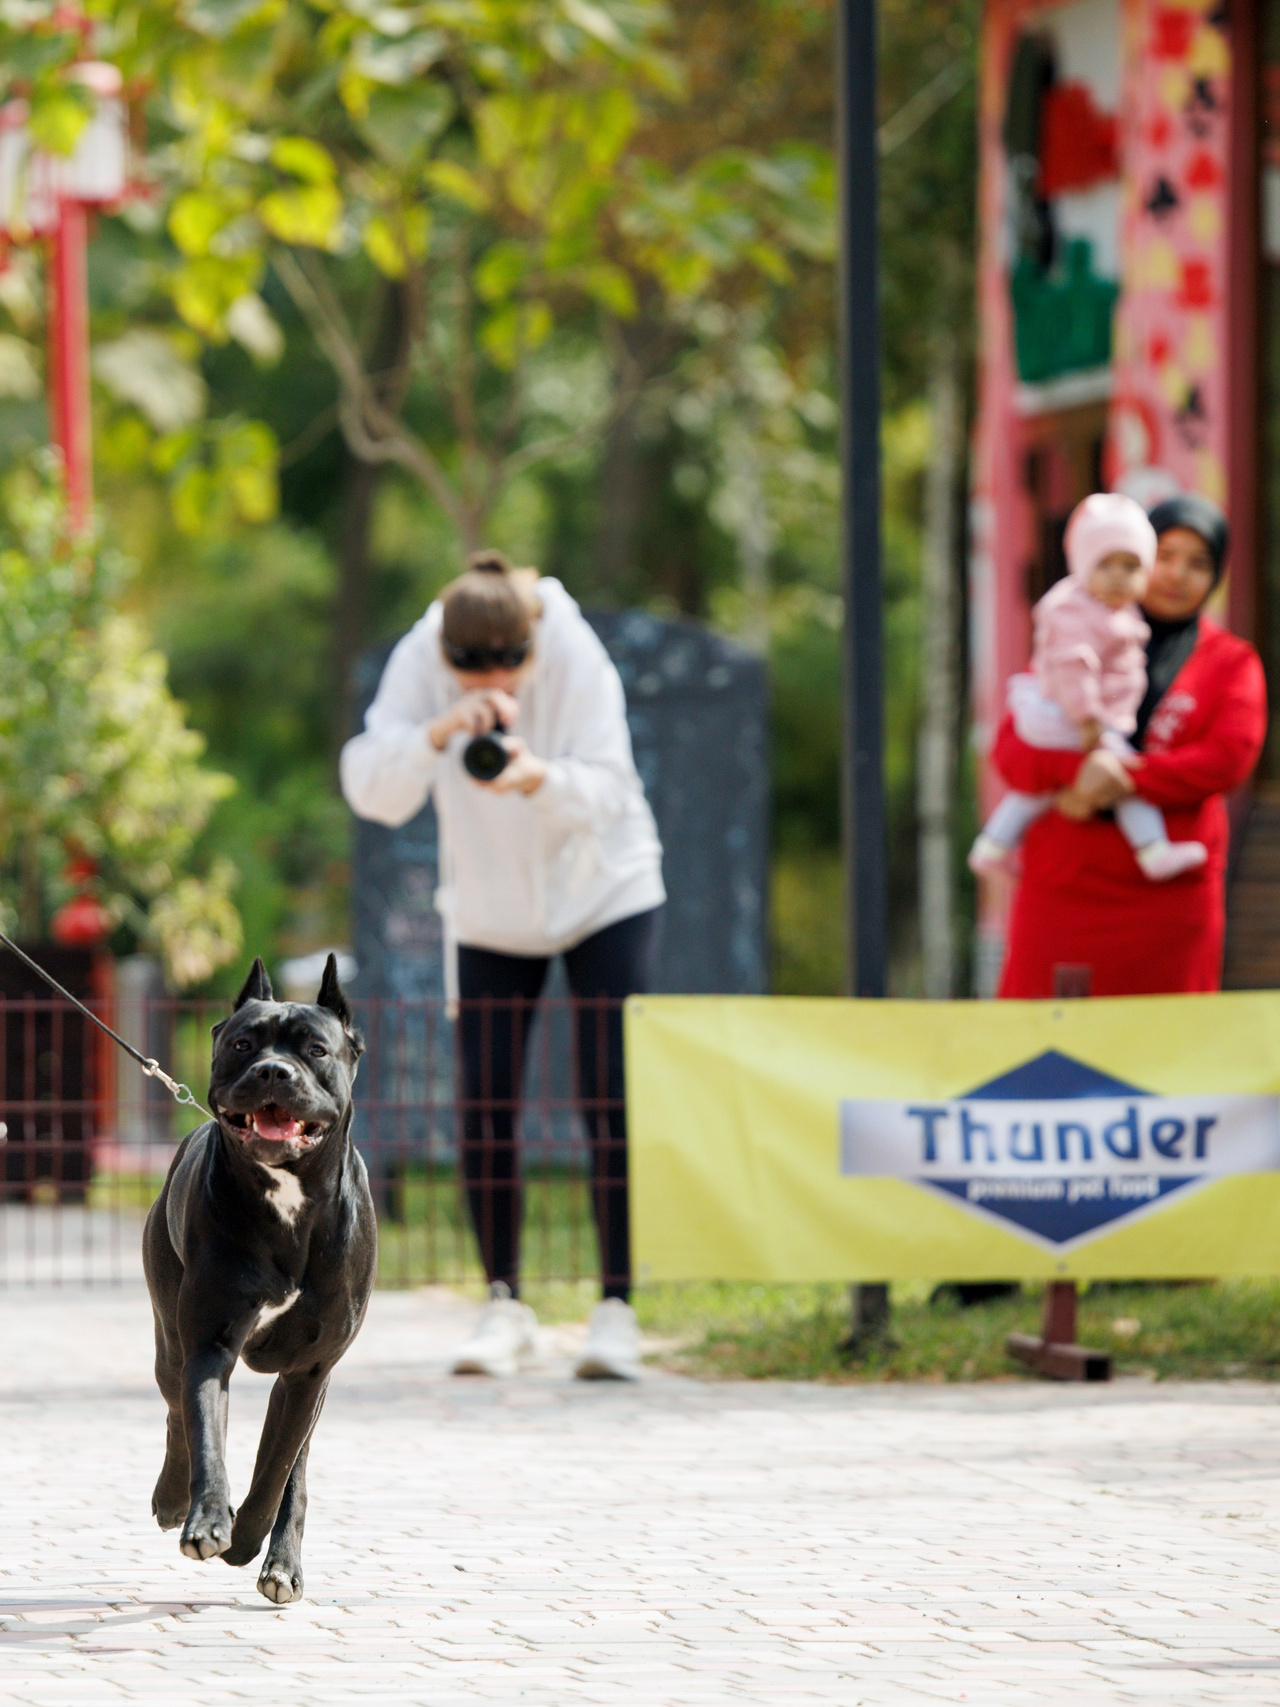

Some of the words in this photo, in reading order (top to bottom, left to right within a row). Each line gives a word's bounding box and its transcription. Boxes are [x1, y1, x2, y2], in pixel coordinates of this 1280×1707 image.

[905, 1104, 1217, 1162] Thunder
[967, 1178, 1065, 1203] premium
[1067, 1177, 1105, 1205] pet
